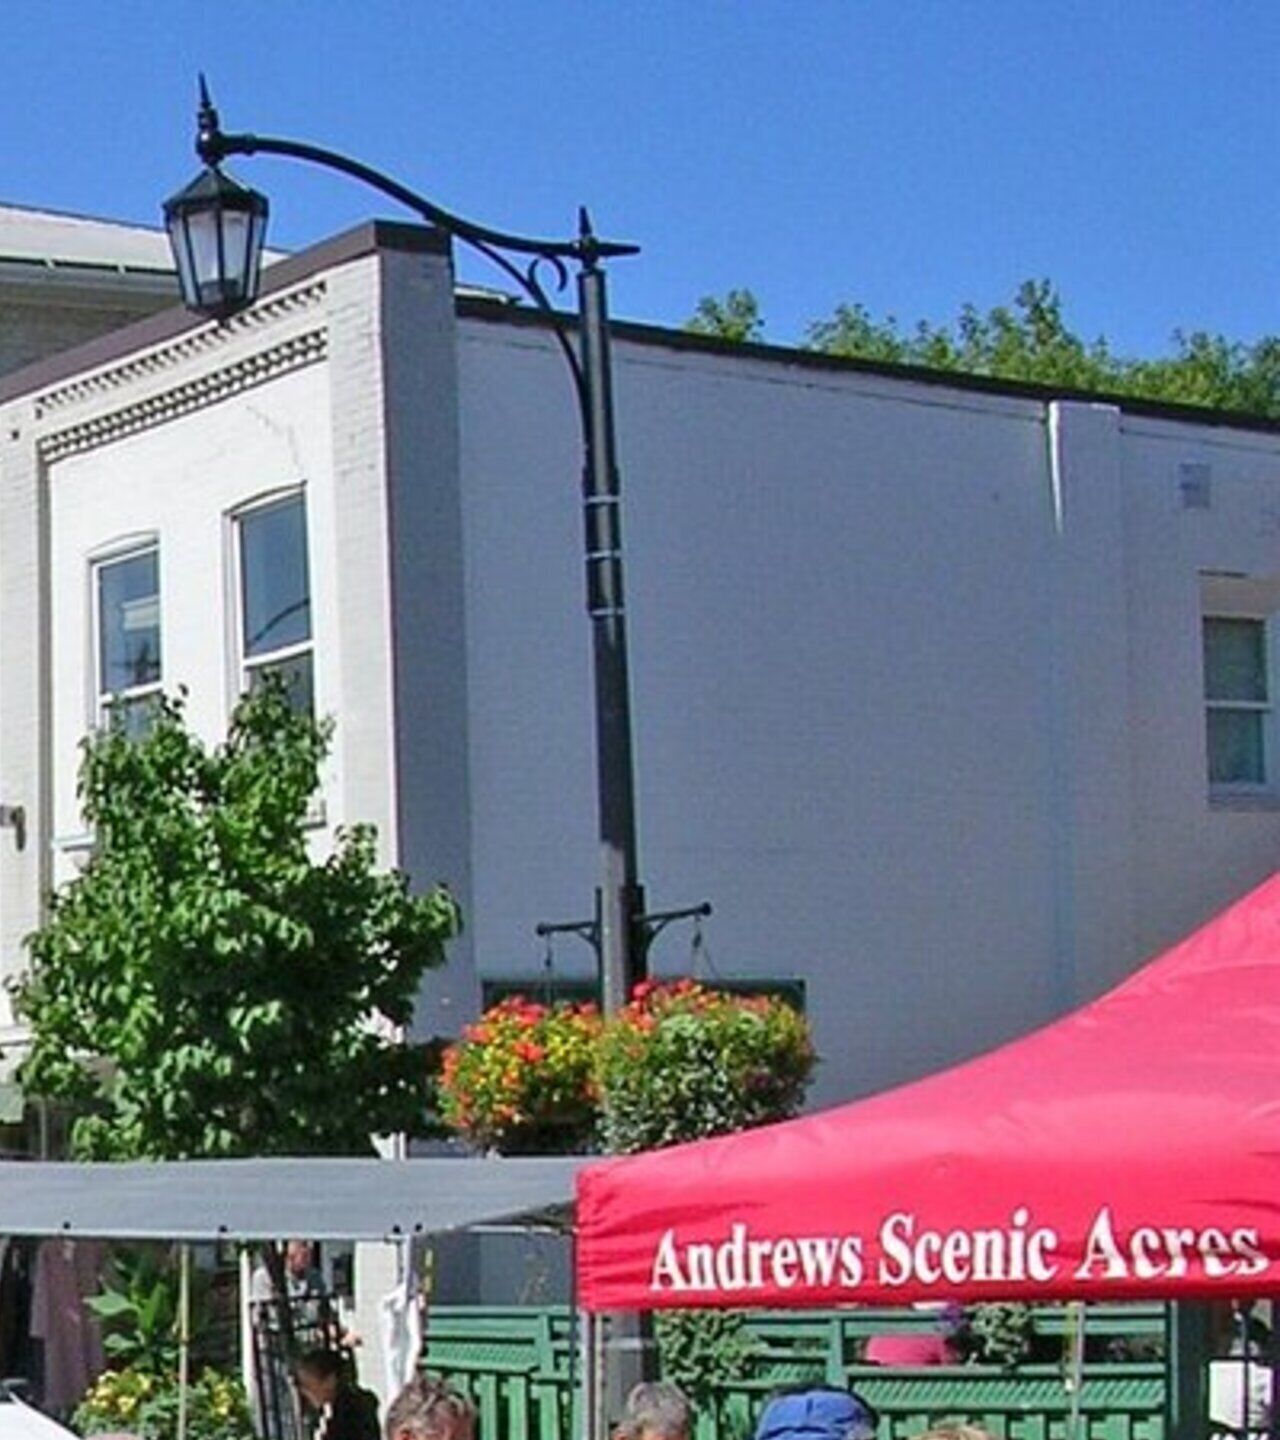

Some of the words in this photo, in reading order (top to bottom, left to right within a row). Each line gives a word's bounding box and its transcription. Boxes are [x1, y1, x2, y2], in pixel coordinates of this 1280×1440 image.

[649, 1221, 862, 1292] Andrews
[878, 1208, 1058, 1286] Scenic
[1073, 1204, 1270, 1280] Acres
